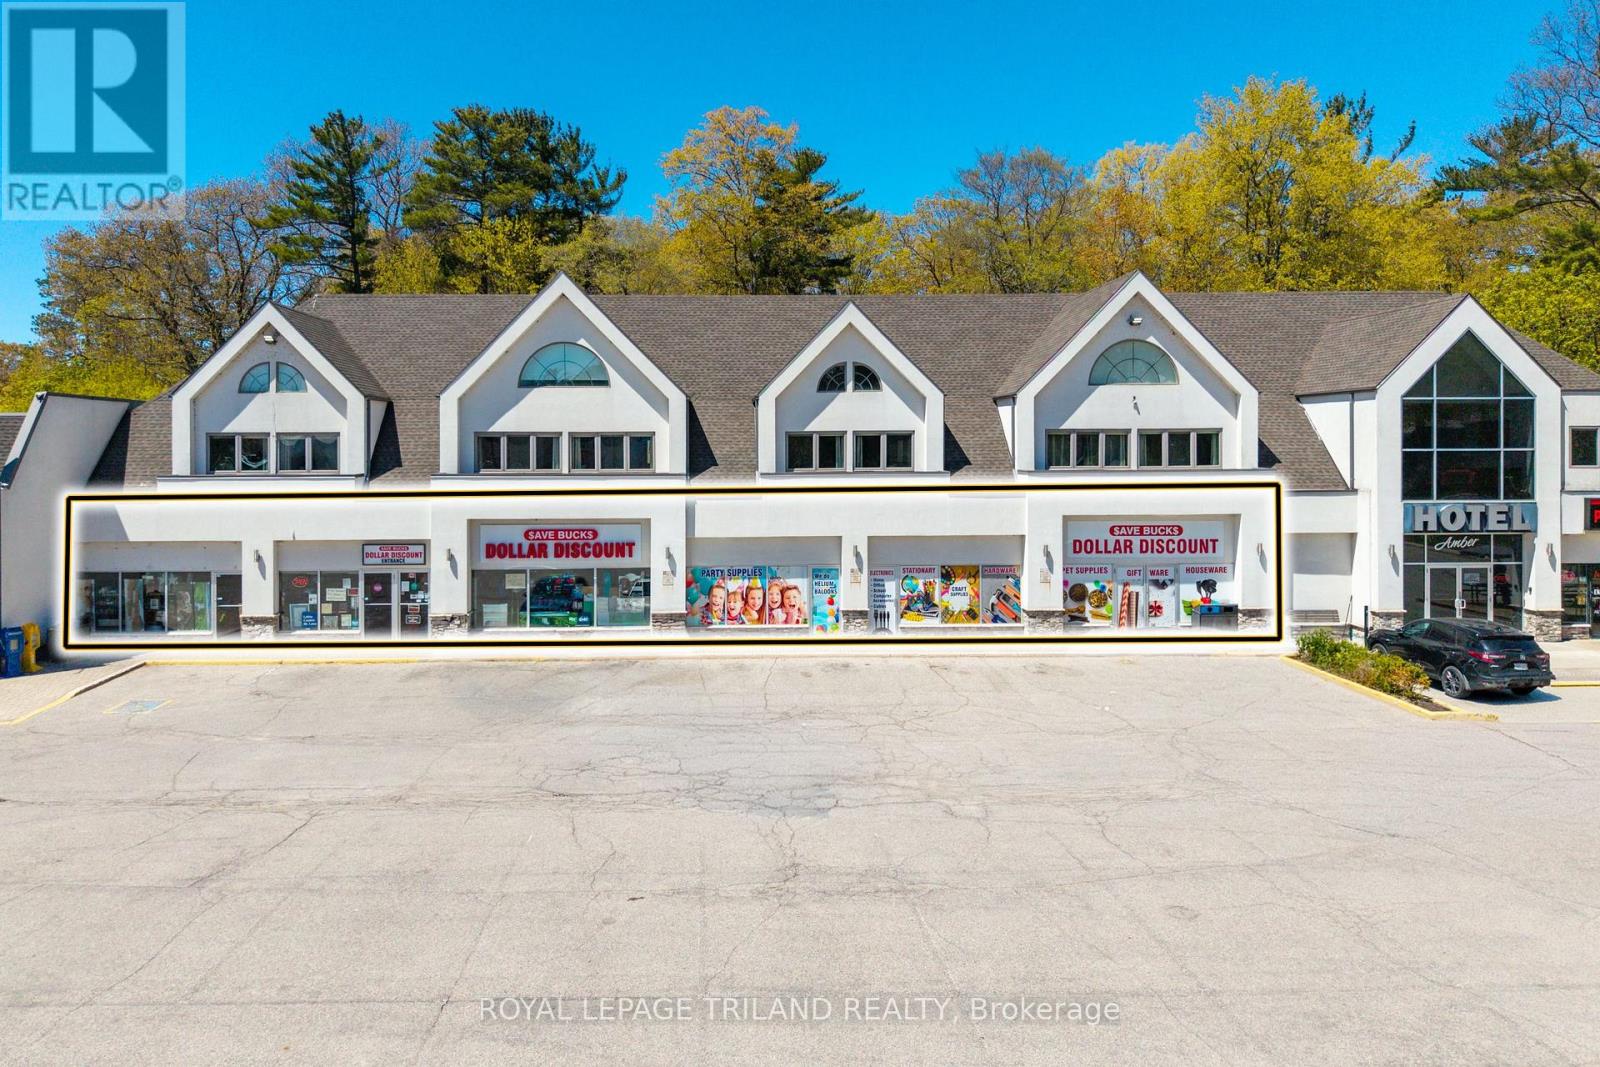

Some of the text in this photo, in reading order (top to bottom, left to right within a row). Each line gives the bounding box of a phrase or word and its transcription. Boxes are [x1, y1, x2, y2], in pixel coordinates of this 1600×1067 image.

[1413, 504, 1533, 532] HOTEL
[528, 530, 594, 540] SAVE BUCKS
[1113, 527, 1179, 536] SAVE BUCKS
[1072, 538, 1219, 554] DOLLAR DISCOUNT
[1434, 536, 1480, 551] Amber
[365, 551, 423, 559] DOLLAR DISCOUNT
[485, 542, 636, 559] DOLLAR DISCOUNT
[701, 568, 763, 578] PARTY SUPPLIES
[1126, 569, 1142, 577] GIFT
[1185, 566, 1228, 574] HOUSEWARE
